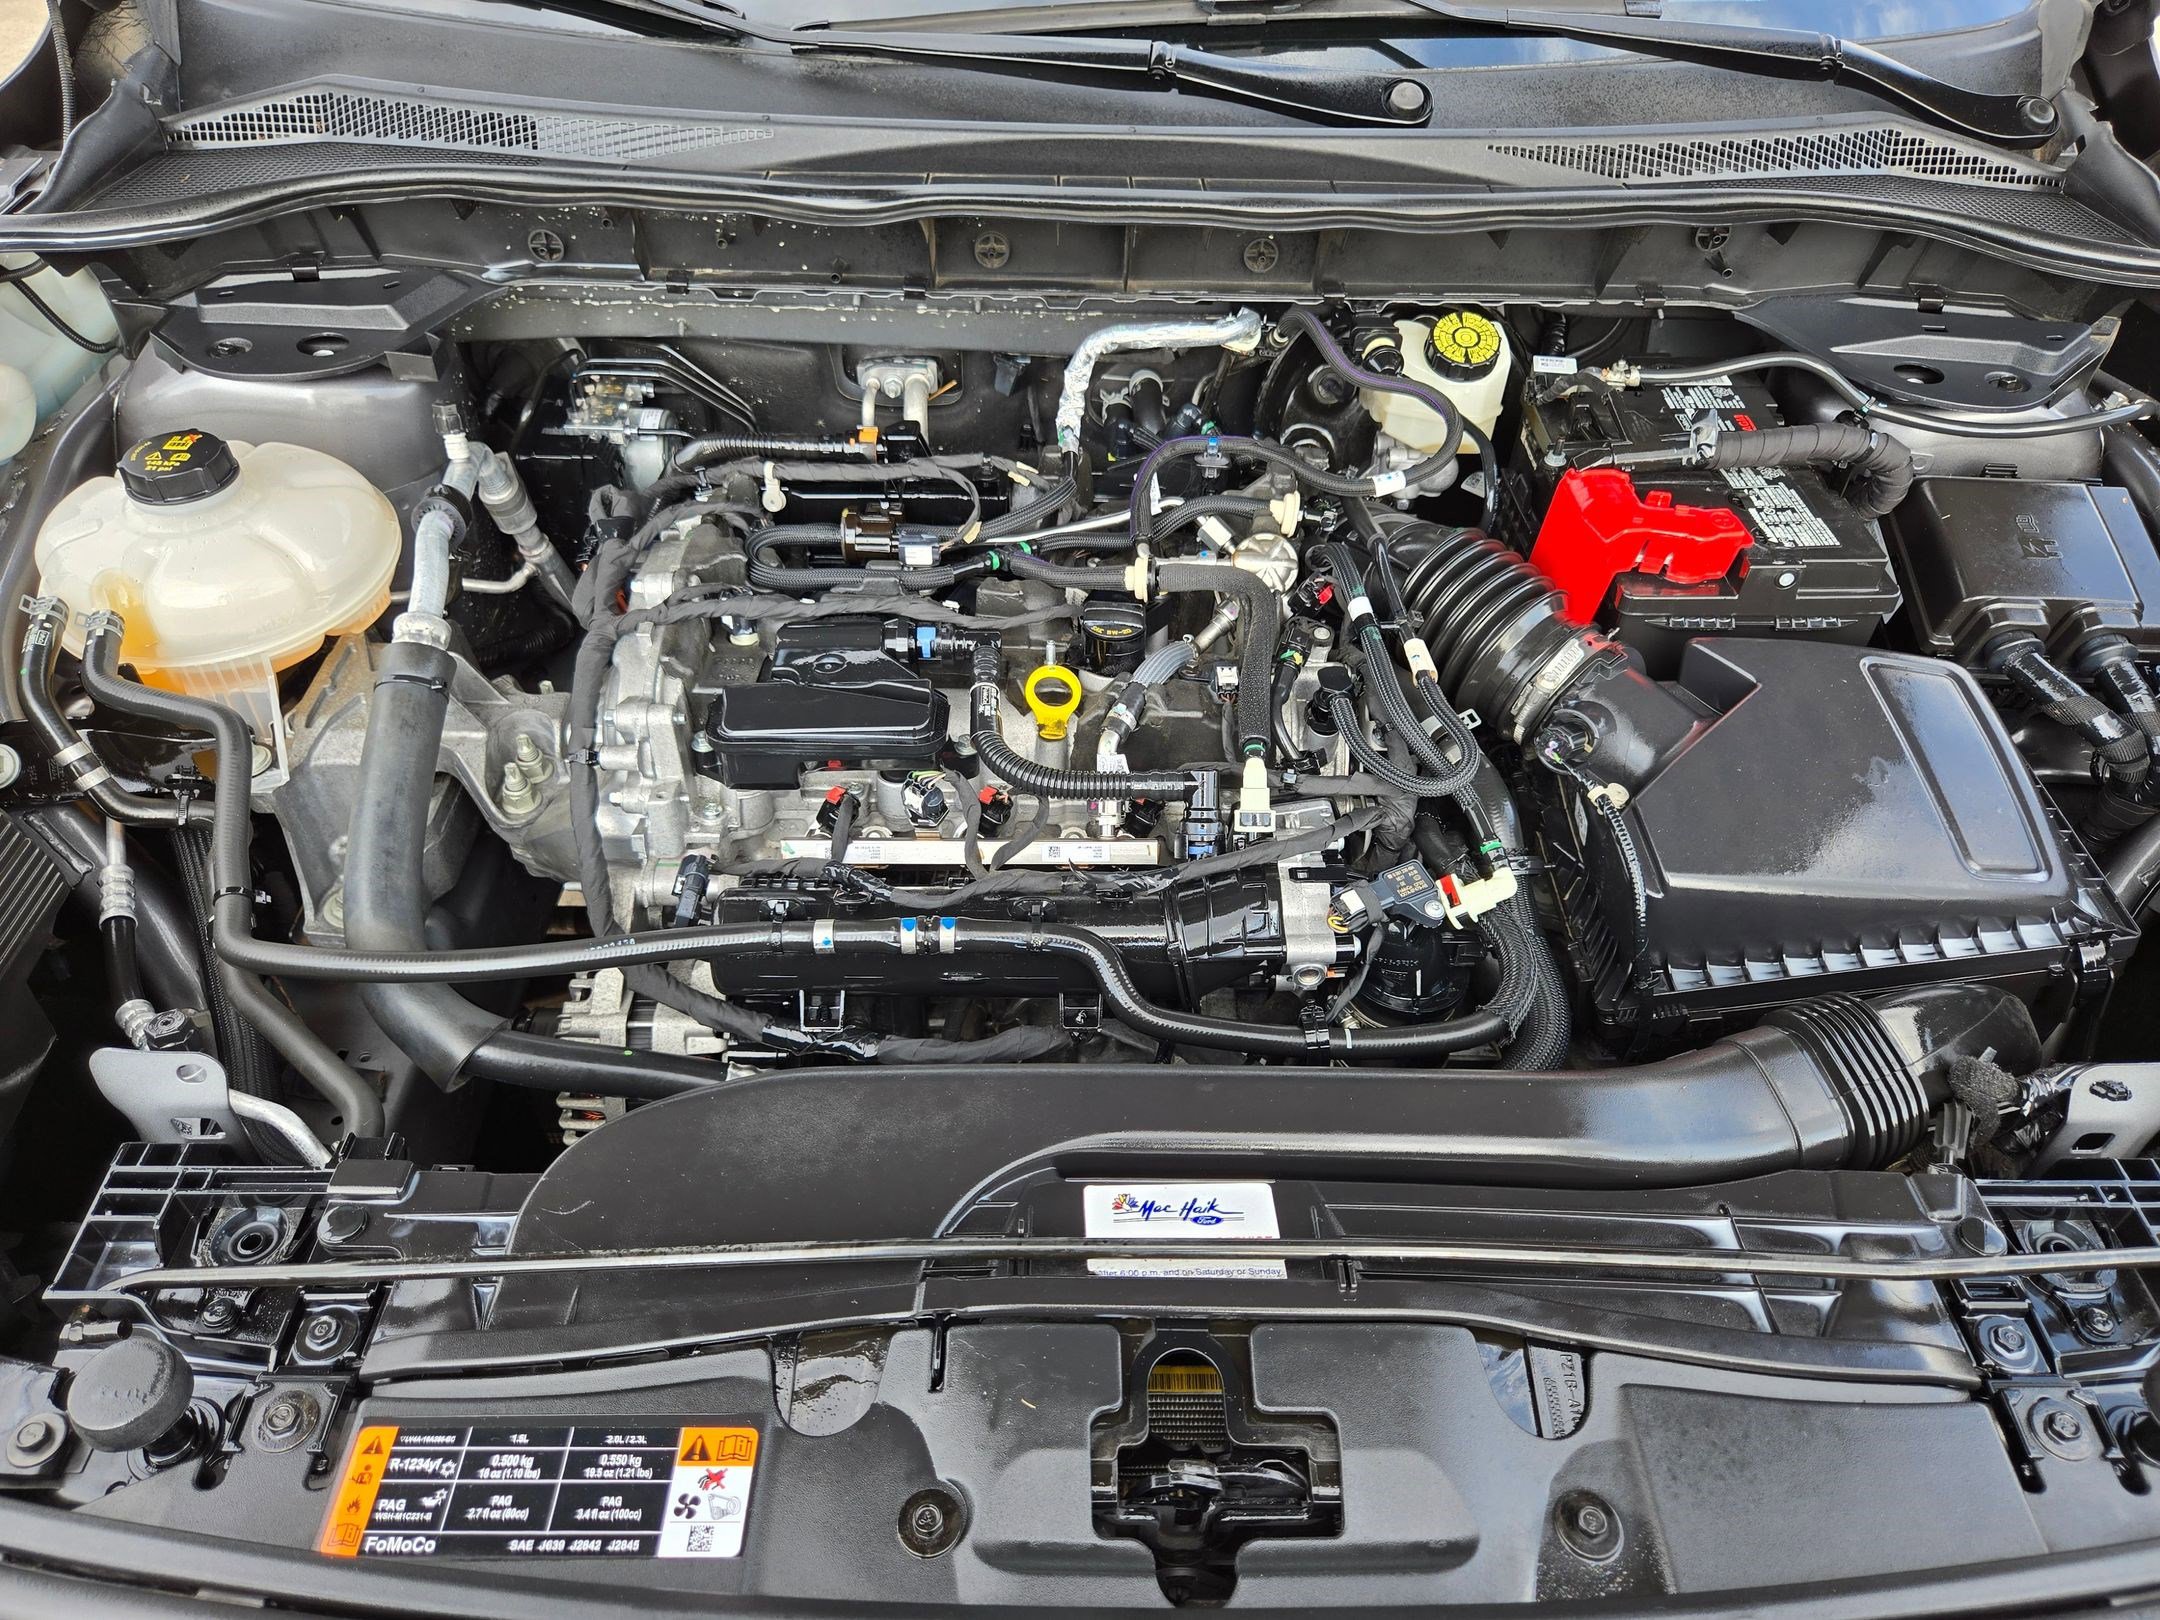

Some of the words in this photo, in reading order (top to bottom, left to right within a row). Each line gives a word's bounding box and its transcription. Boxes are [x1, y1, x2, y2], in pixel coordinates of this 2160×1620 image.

[1140, 1200, 1174, 1221] Mac
[1179, 1198, 1222, 1221] Haik
[1196, 1216, 1218, 1225] Ford
[1195, 1268, 1234, 1277] Saturday
[1247, 1268, 1281, 1276] Sunday
[605, 1435, 624, 1444] 2.0L
[630, 1435, 647, 1444] 2.3L
[389, 1457, 443, 1473] R-1234yf
[491, 1454, 520, 1467] 0.500
[521, 1454, 534, 1469] kg
[600, 1454, 628, 1467] 0.550
[629, 1455, 642, 1468] kg
[490, 1469, 502, 1478] oz
[603, 1469, 615, 1478] oz
[636, 1468, 653, 1480] lbs)
[378, 1499, 406, 1512] PAG
[490, 1495, 513, 1507] PAG
[600, 1496, 622, 1507] PAG
[490, 1510, 502, 1519] oz
[598, 1510, 610, 1519] oz
[364, 1537, 436, 1553] FoMoCo
[508, 1540, 534, 1552] SAE
[537, 1540, 565, 1552] J639
